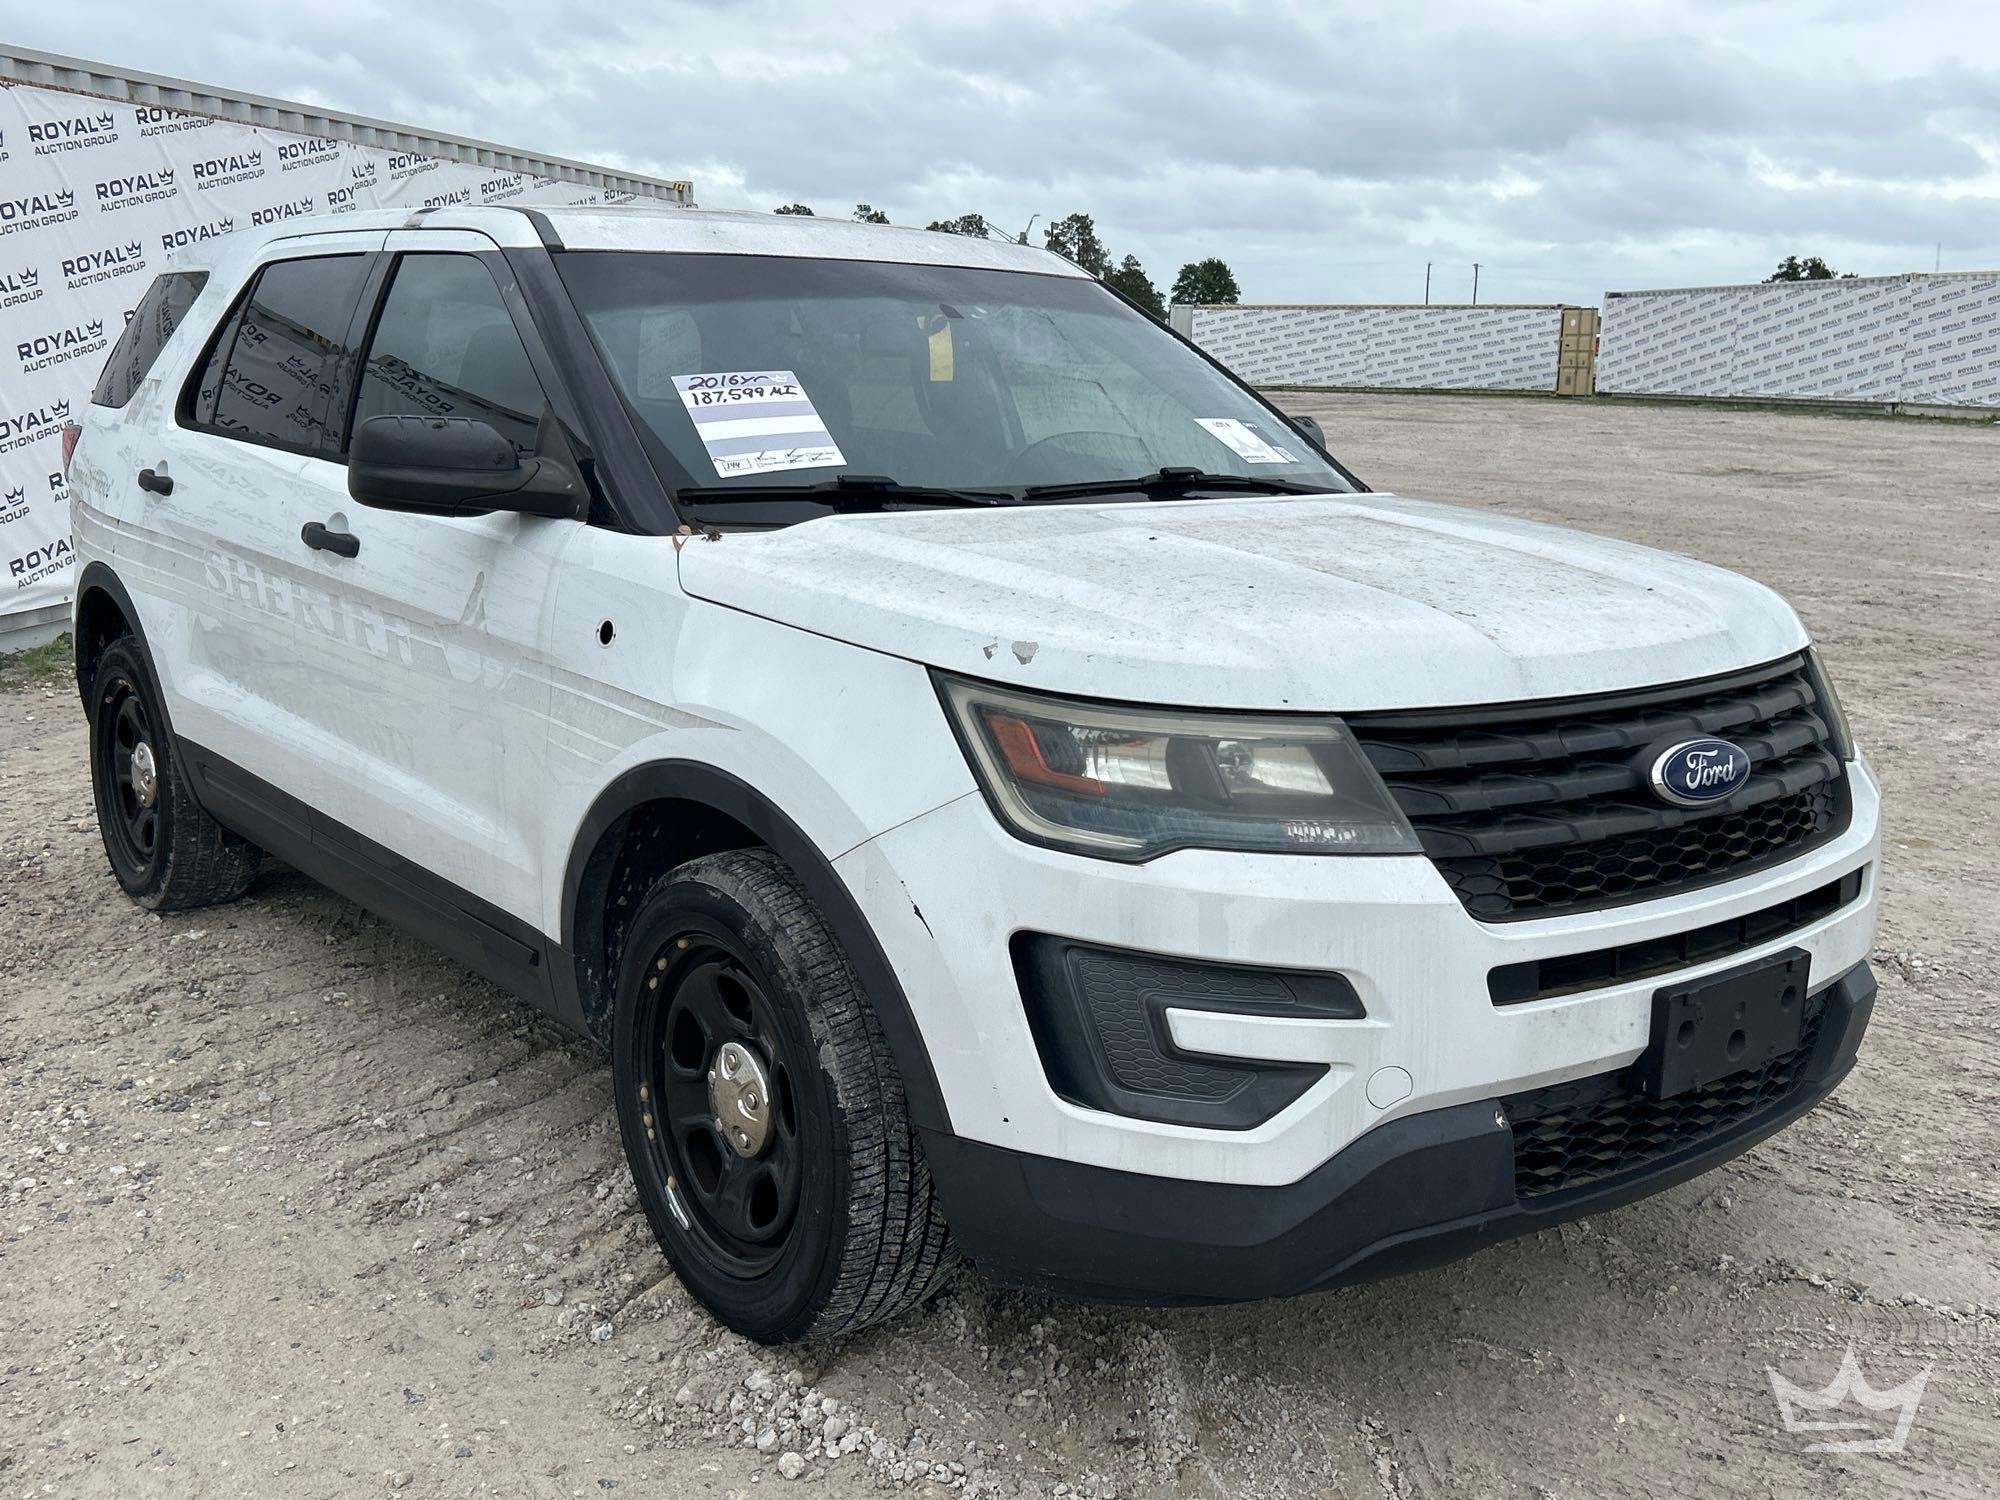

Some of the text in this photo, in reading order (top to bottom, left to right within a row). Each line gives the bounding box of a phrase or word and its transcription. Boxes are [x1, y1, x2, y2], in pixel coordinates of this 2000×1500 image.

[28, 117, 98, 142] ROYAL
[140, 120, 214, 137] AUCTION GROUP
[34, 134, 118, 156] AUCTION GROUP
[278, 140, 326, 160] ROYAL
[193, 155, 249, 178] ROYAL
[282, 152, 340, 171] AUCTION GROUP
[96, 174, 159, 200] ROYAL
[198, 169, 265, 191] AUCTION GROUP
[354, 178, 377, 190] GROUP
[481, 176, 514, 195] ROYAL
[0, 195, 58, 220] OYAL
[101, 188, 177, 212] AUCTION GROUP
[328, 186, 355, 205] ROY
[0, 210, 78, 236] UCTION GROUP
[252, 202, 302, 226] ROYAL
[162, 222, 220, 250] ROYAL
[62, 248, 127, 277] ROYAL
[68, 261, 145, 290] AUCTION GROUP
[4, 290, 43, 307] GROUP
[17, 327, 88, 360] ROYAL
[24, 339, 107, 374] AUCTION GROUP
[0, 434, 34, 453] CTION
[0, 506, 30, 524] ROUP
[18, 561, 63, 589] AUCTION
[1686, 750, 1736, 790] Ford
